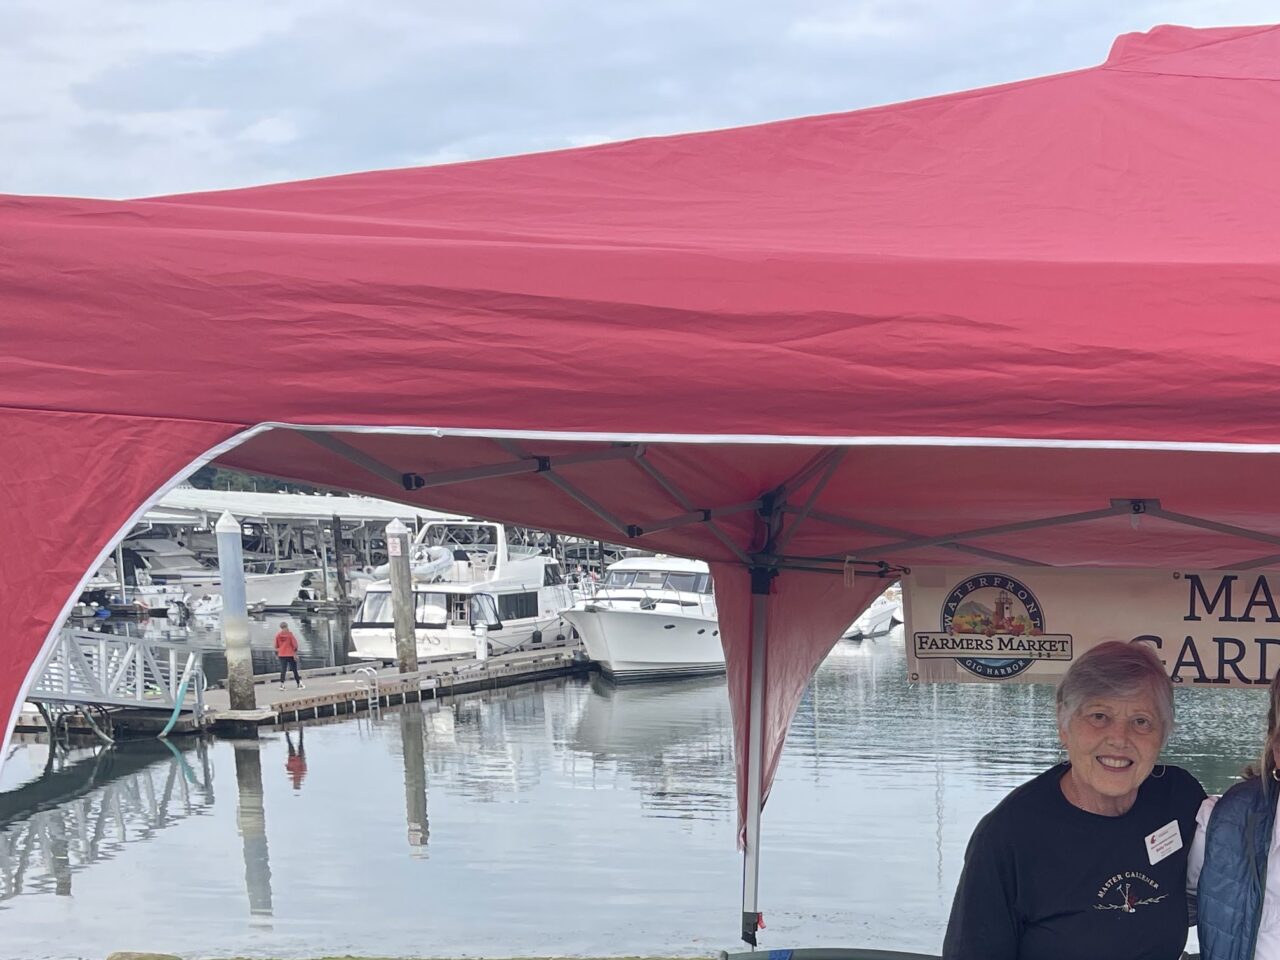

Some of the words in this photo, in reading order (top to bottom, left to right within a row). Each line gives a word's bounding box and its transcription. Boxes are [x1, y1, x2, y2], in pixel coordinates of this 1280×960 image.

[945, 577, 1041, 629] WATERFRONT
[917, 635, 994, 651] FARMERS
[998, 637, 1069, 653] MARKET
[965, 659, 983, 673] GIG
[986, 660, 1026, 676] HARBOR
